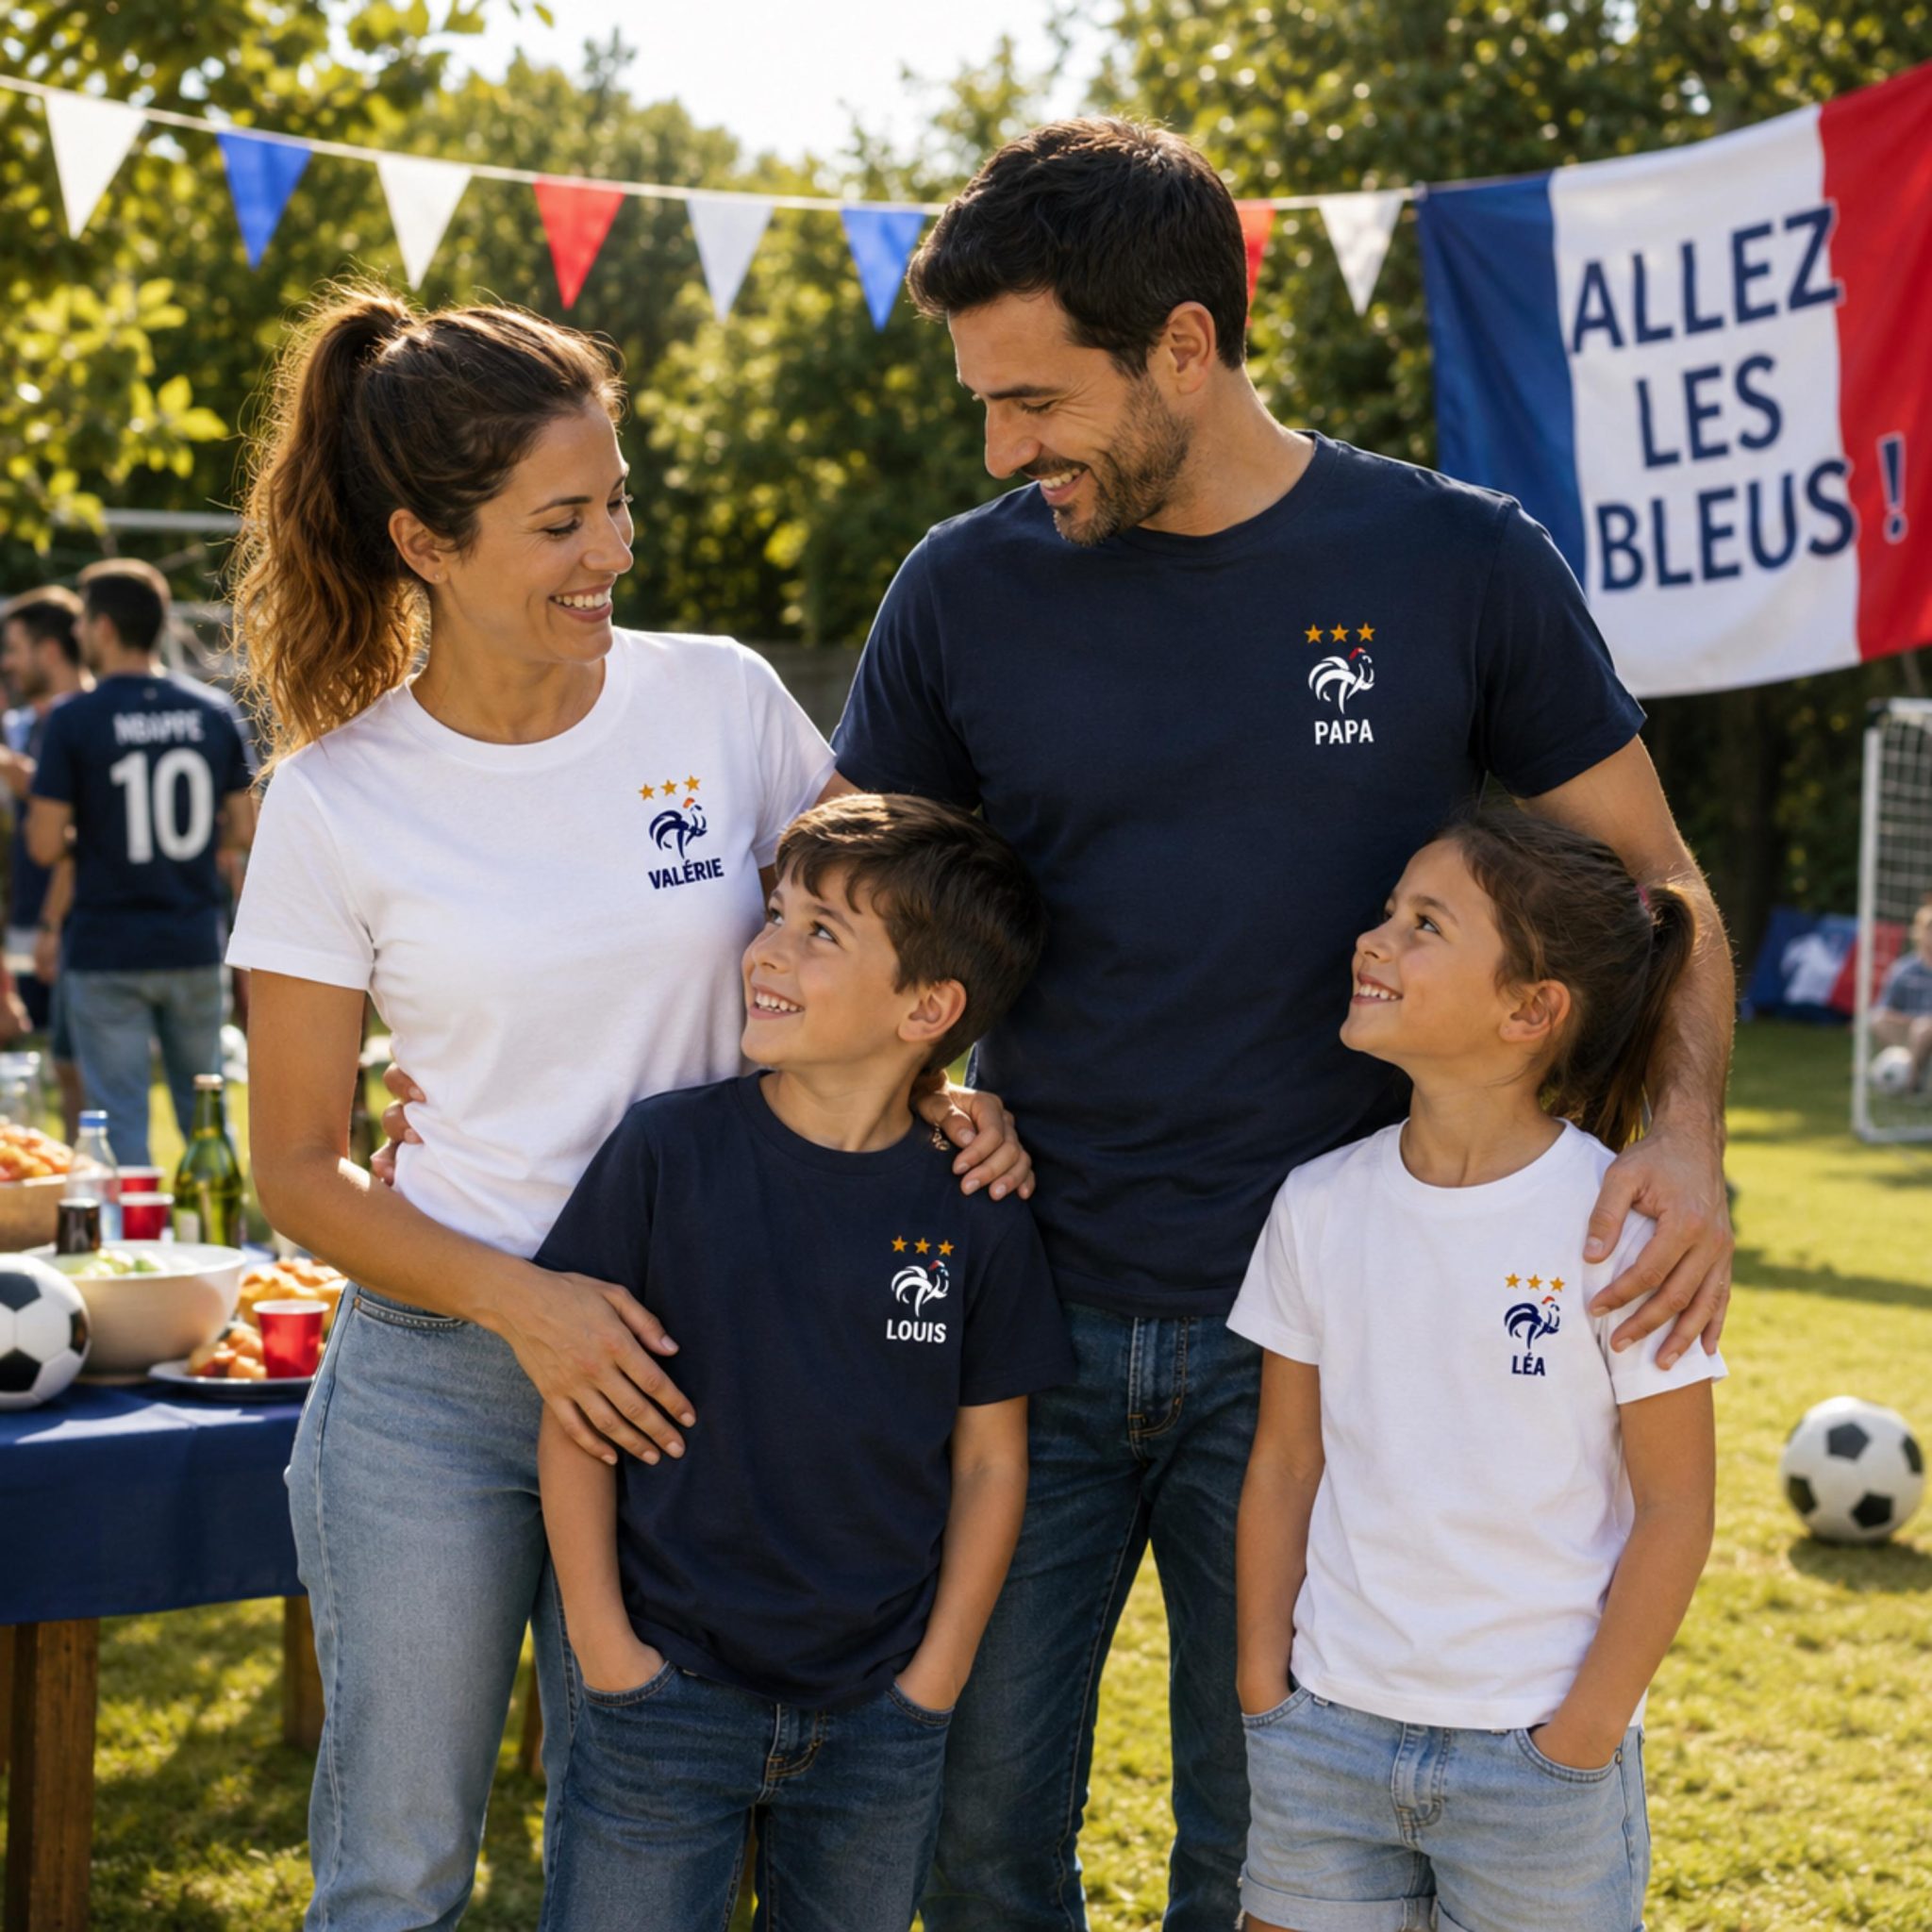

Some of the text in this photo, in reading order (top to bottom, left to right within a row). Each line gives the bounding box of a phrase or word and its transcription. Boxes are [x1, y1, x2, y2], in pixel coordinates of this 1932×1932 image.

[1570, 204, 1843, 354] ALLEZ
[1636, 354, 1783, 470] LES
[1596, 434, 1907, 591] BLEUS !
[1314, 719, 1374, 745] PAPA
[109, 747, 214, 864] 10
[648, 858, 724, 890] VALÉRIE
[886, 1319, 947, 1344] LOUIS
[1511, 1352, 1546, 1376] LÉA
